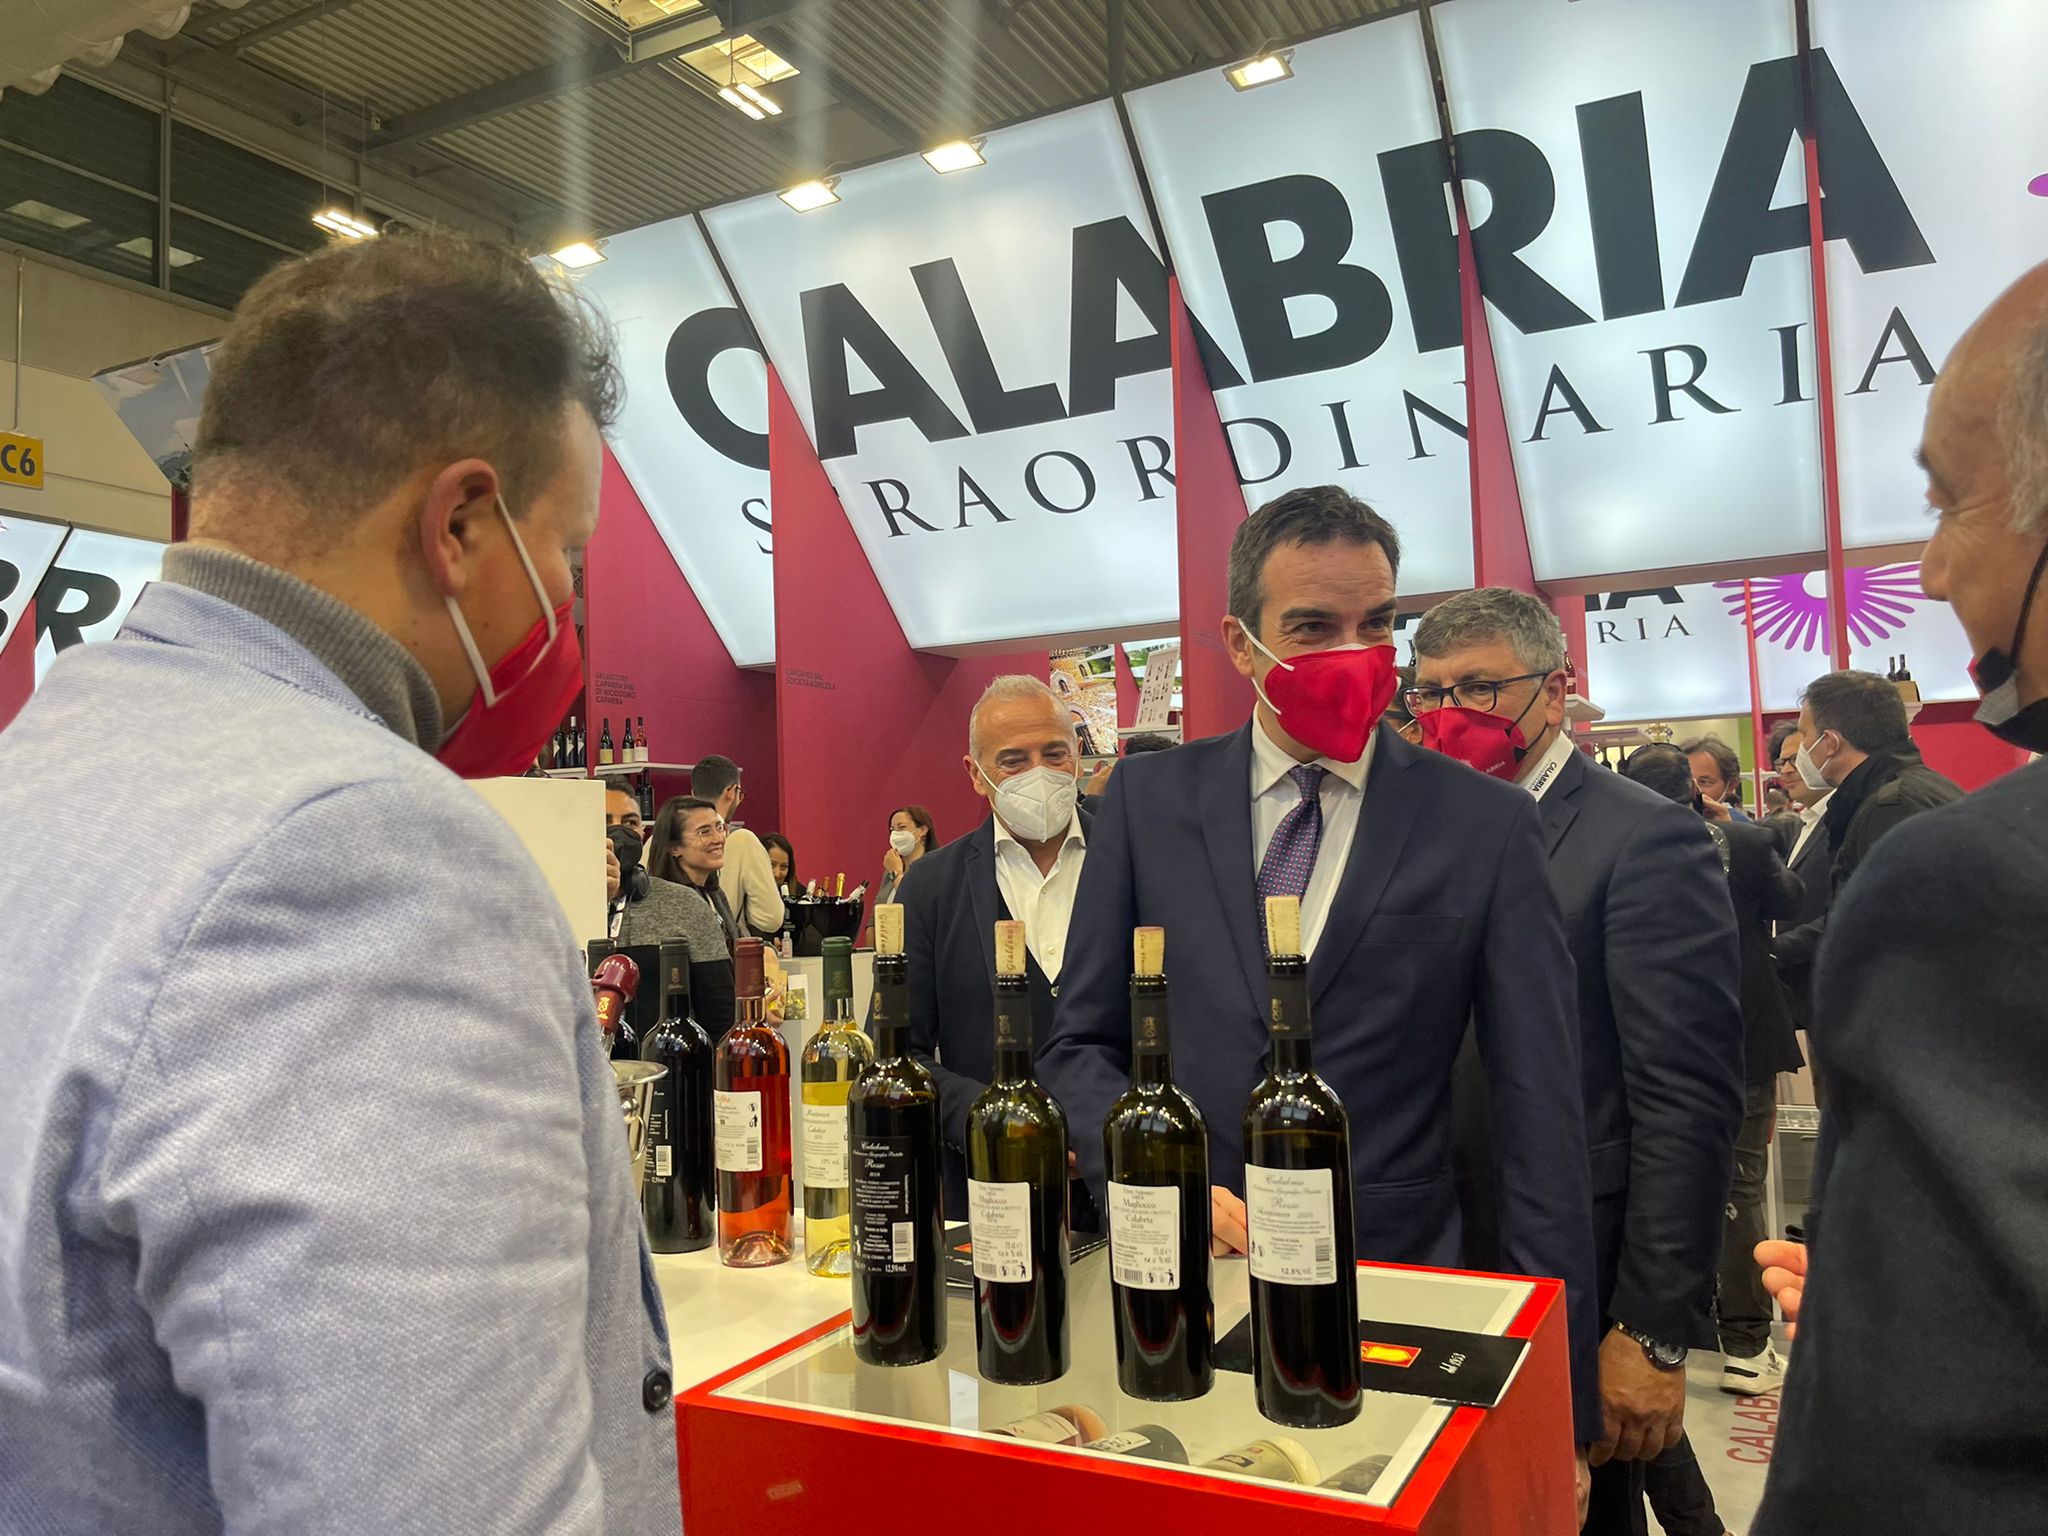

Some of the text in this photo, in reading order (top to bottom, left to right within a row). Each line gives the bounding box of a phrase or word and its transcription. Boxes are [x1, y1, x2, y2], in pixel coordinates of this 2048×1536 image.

[664, 47, 1936, 471] CALABRIA
[1, 444, 35, 477] C6
[741, 307, 1936, 554] SRAORDINARIA
[1532, 761, 1557, 792] CALABRIA
